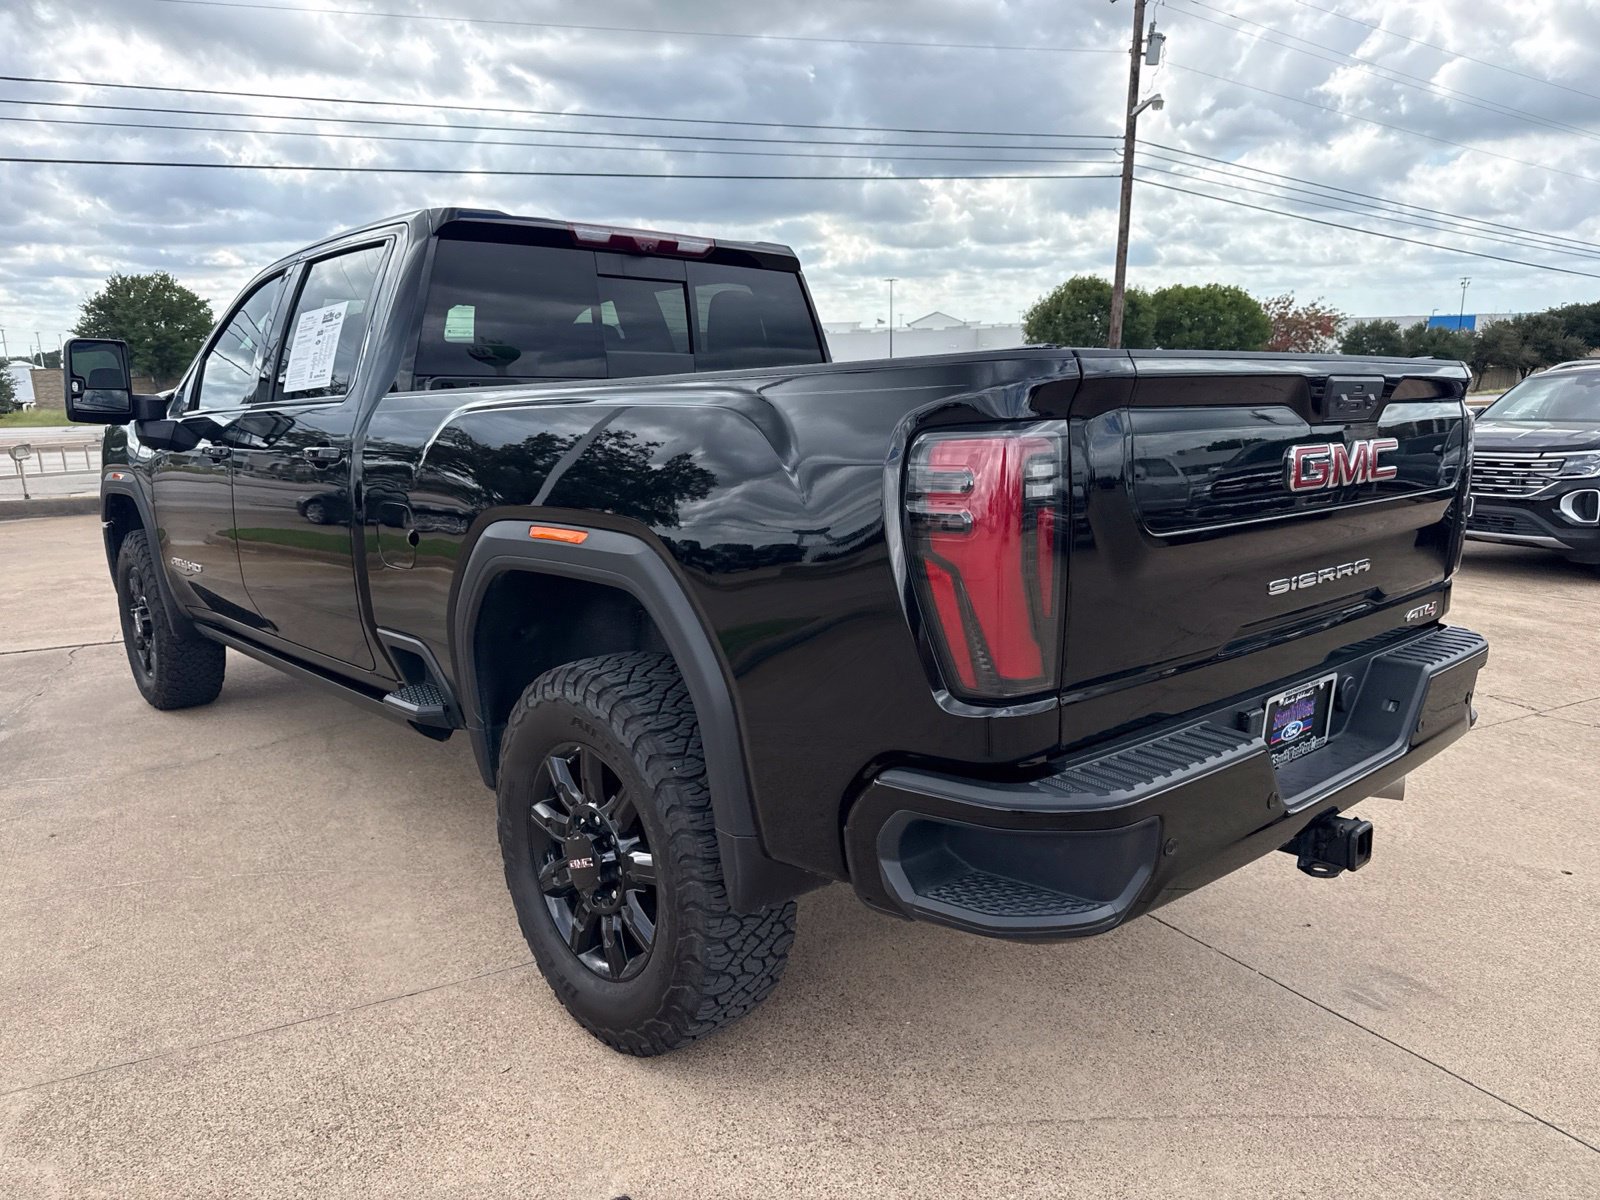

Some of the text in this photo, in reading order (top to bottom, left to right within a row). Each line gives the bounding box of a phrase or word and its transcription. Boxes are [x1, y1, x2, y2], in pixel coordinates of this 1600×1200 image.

[1285, 438, 1398, 492] GMC
[1267, 558, 1371, 595] SIERRA
[1405, 601, 1438, 622] AT4
[569, 857, 593, 869] GMC
